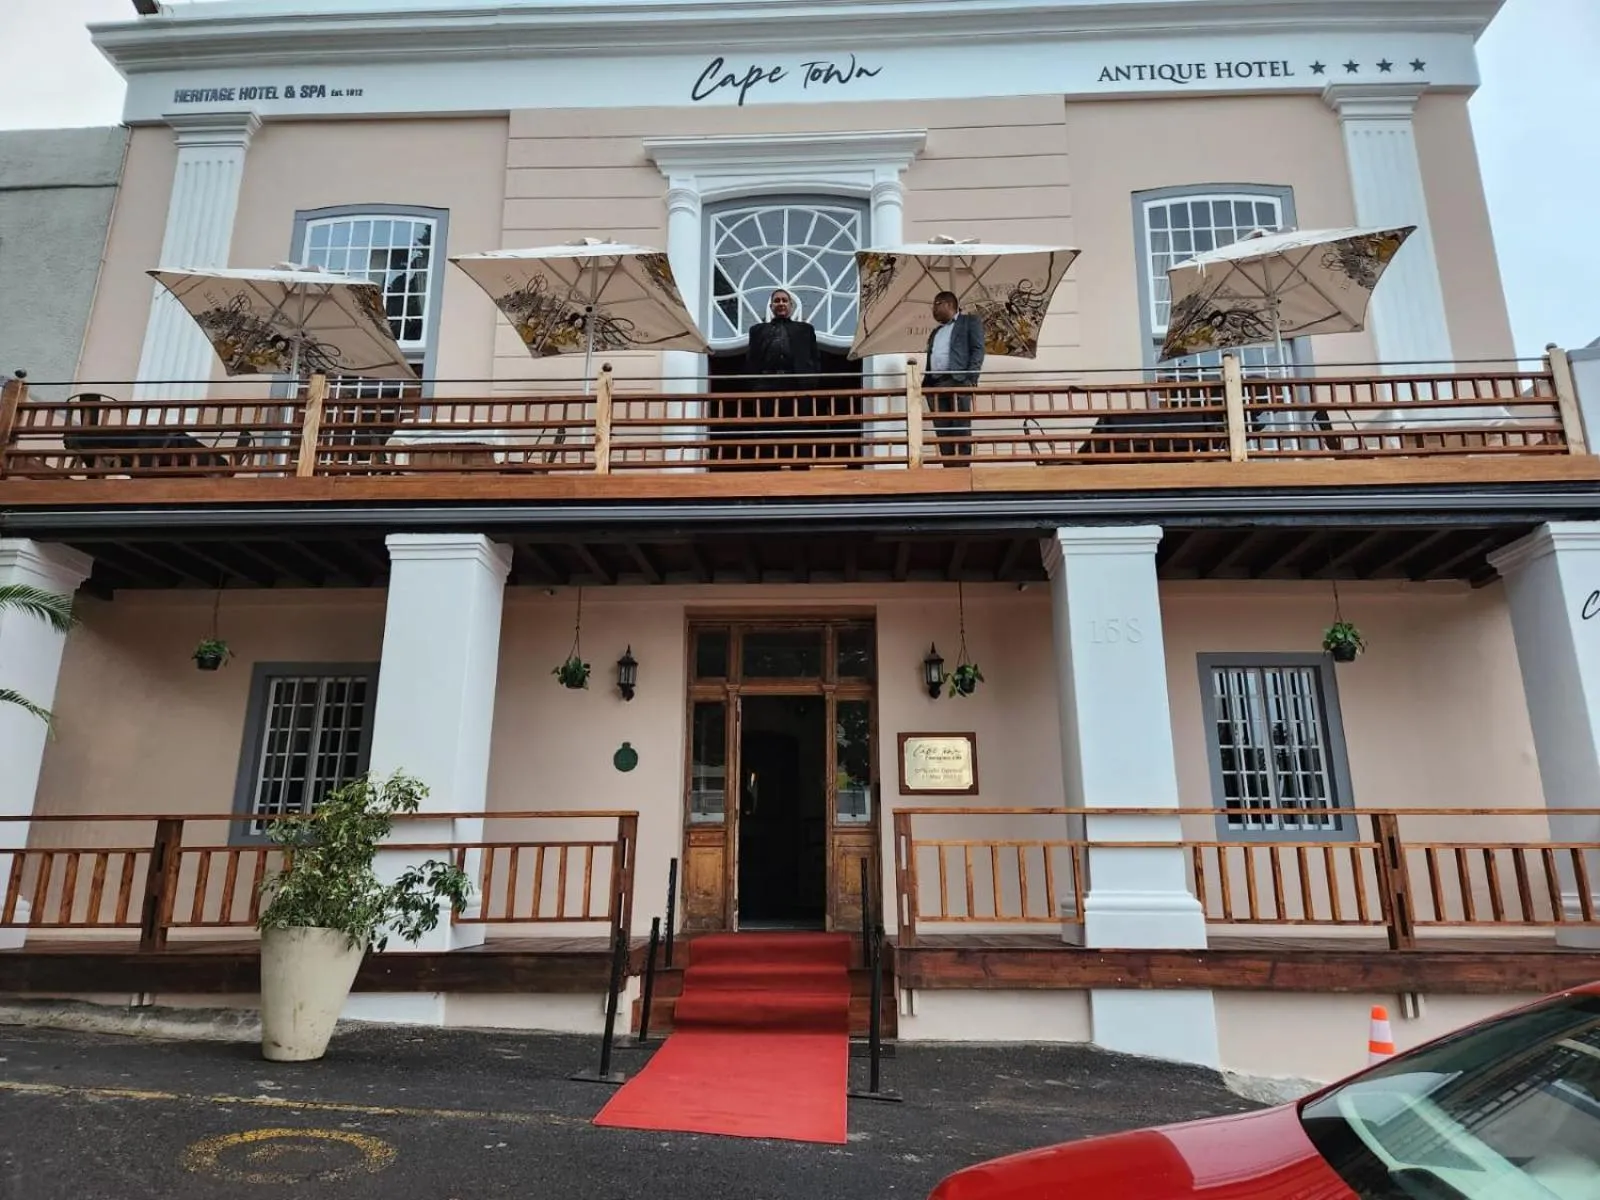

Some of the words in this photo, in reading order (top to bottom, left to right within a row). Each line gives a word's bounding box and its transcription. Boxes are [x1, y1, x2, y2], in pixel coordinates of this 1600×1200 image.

[691, 56, 790, 107] Cape
[1097, 62, 1206, 85] ANTIQUE
[1215, 60, 1296, 79] HOTEL
[173, 87, 236, 103] HERITAGE
[238, 85, 280, 101] HOTEL
[284, 85, 296, 99] &
[299, 84, 327, 99] SPA
[1089, 617, 1143, 645] 158
